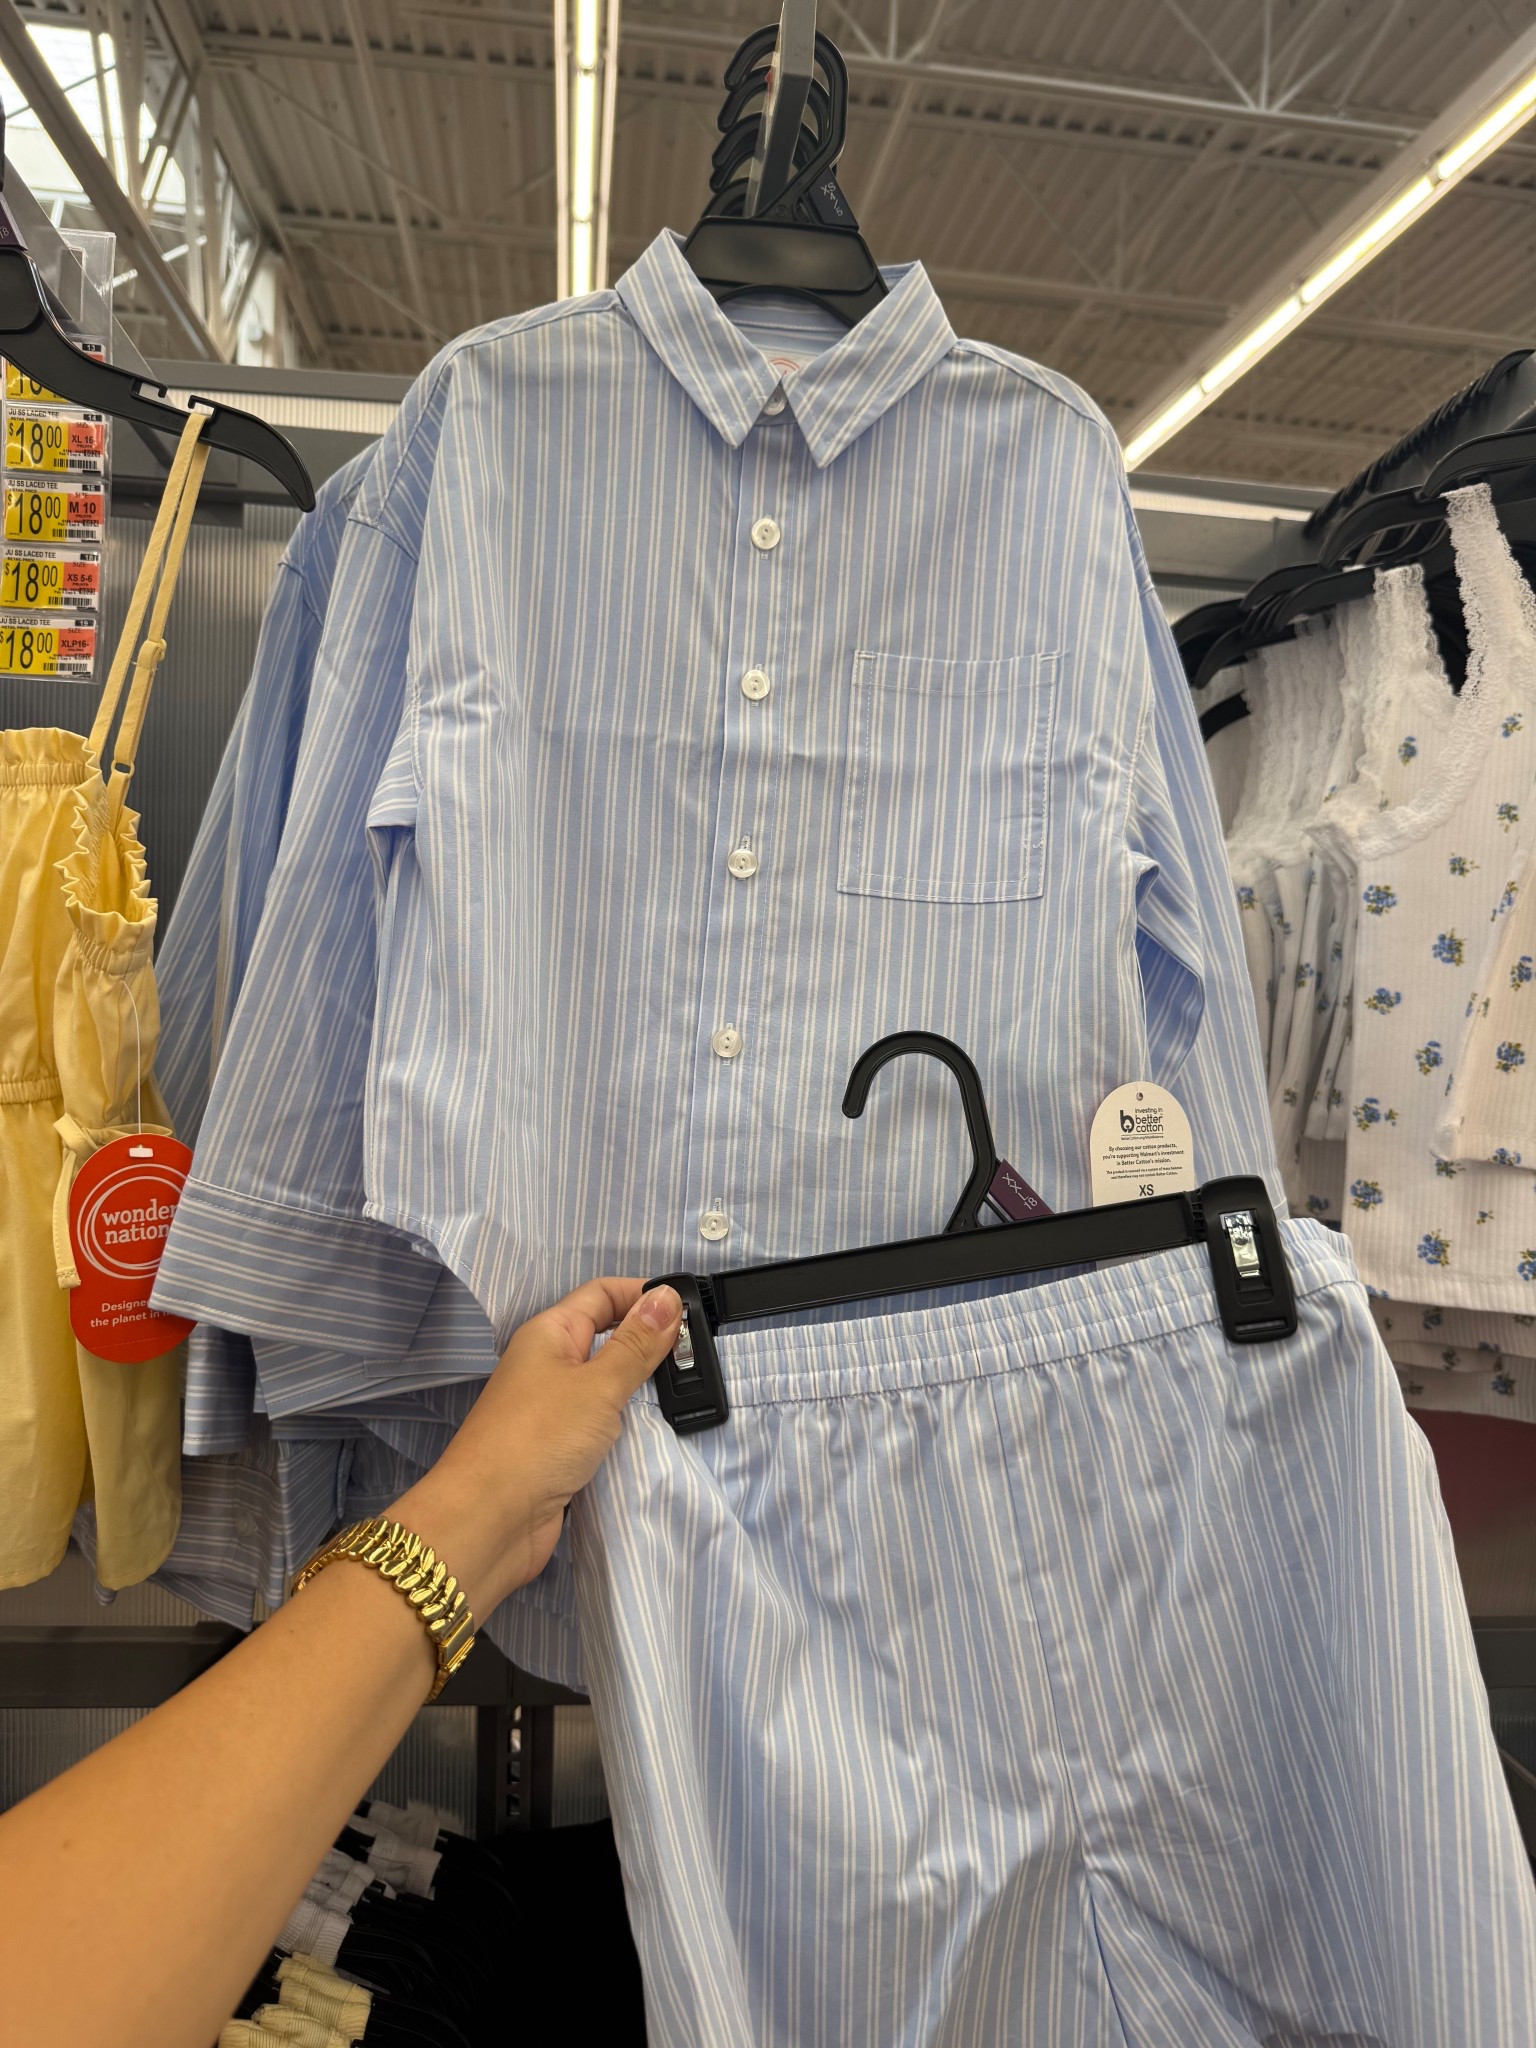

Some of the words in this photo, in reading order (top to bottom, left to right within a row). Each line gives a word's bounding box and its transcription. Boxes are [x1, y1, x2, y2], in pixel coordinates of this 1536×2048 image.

[72, 435, 82, 444] XL
[69, 502, 79, 513] M
[83, 502, 96, 514] 10
[67, 573, 79, 582] XS
[1136, 1124, 1164, 1133] cotton
[1139, 1184, 1155, 1197] XS
[1023, 1197, 1038, 1210] 18
[101, 1198, 177, 1226] wonder
[105, 1222, 170, 1245] nation
[101, 1299, 148, 1313] Designe
[90, 1317, 109, 1328] the
[112, 1311, 147, 1327] planet
[150, 1309, 160, 1319] in
